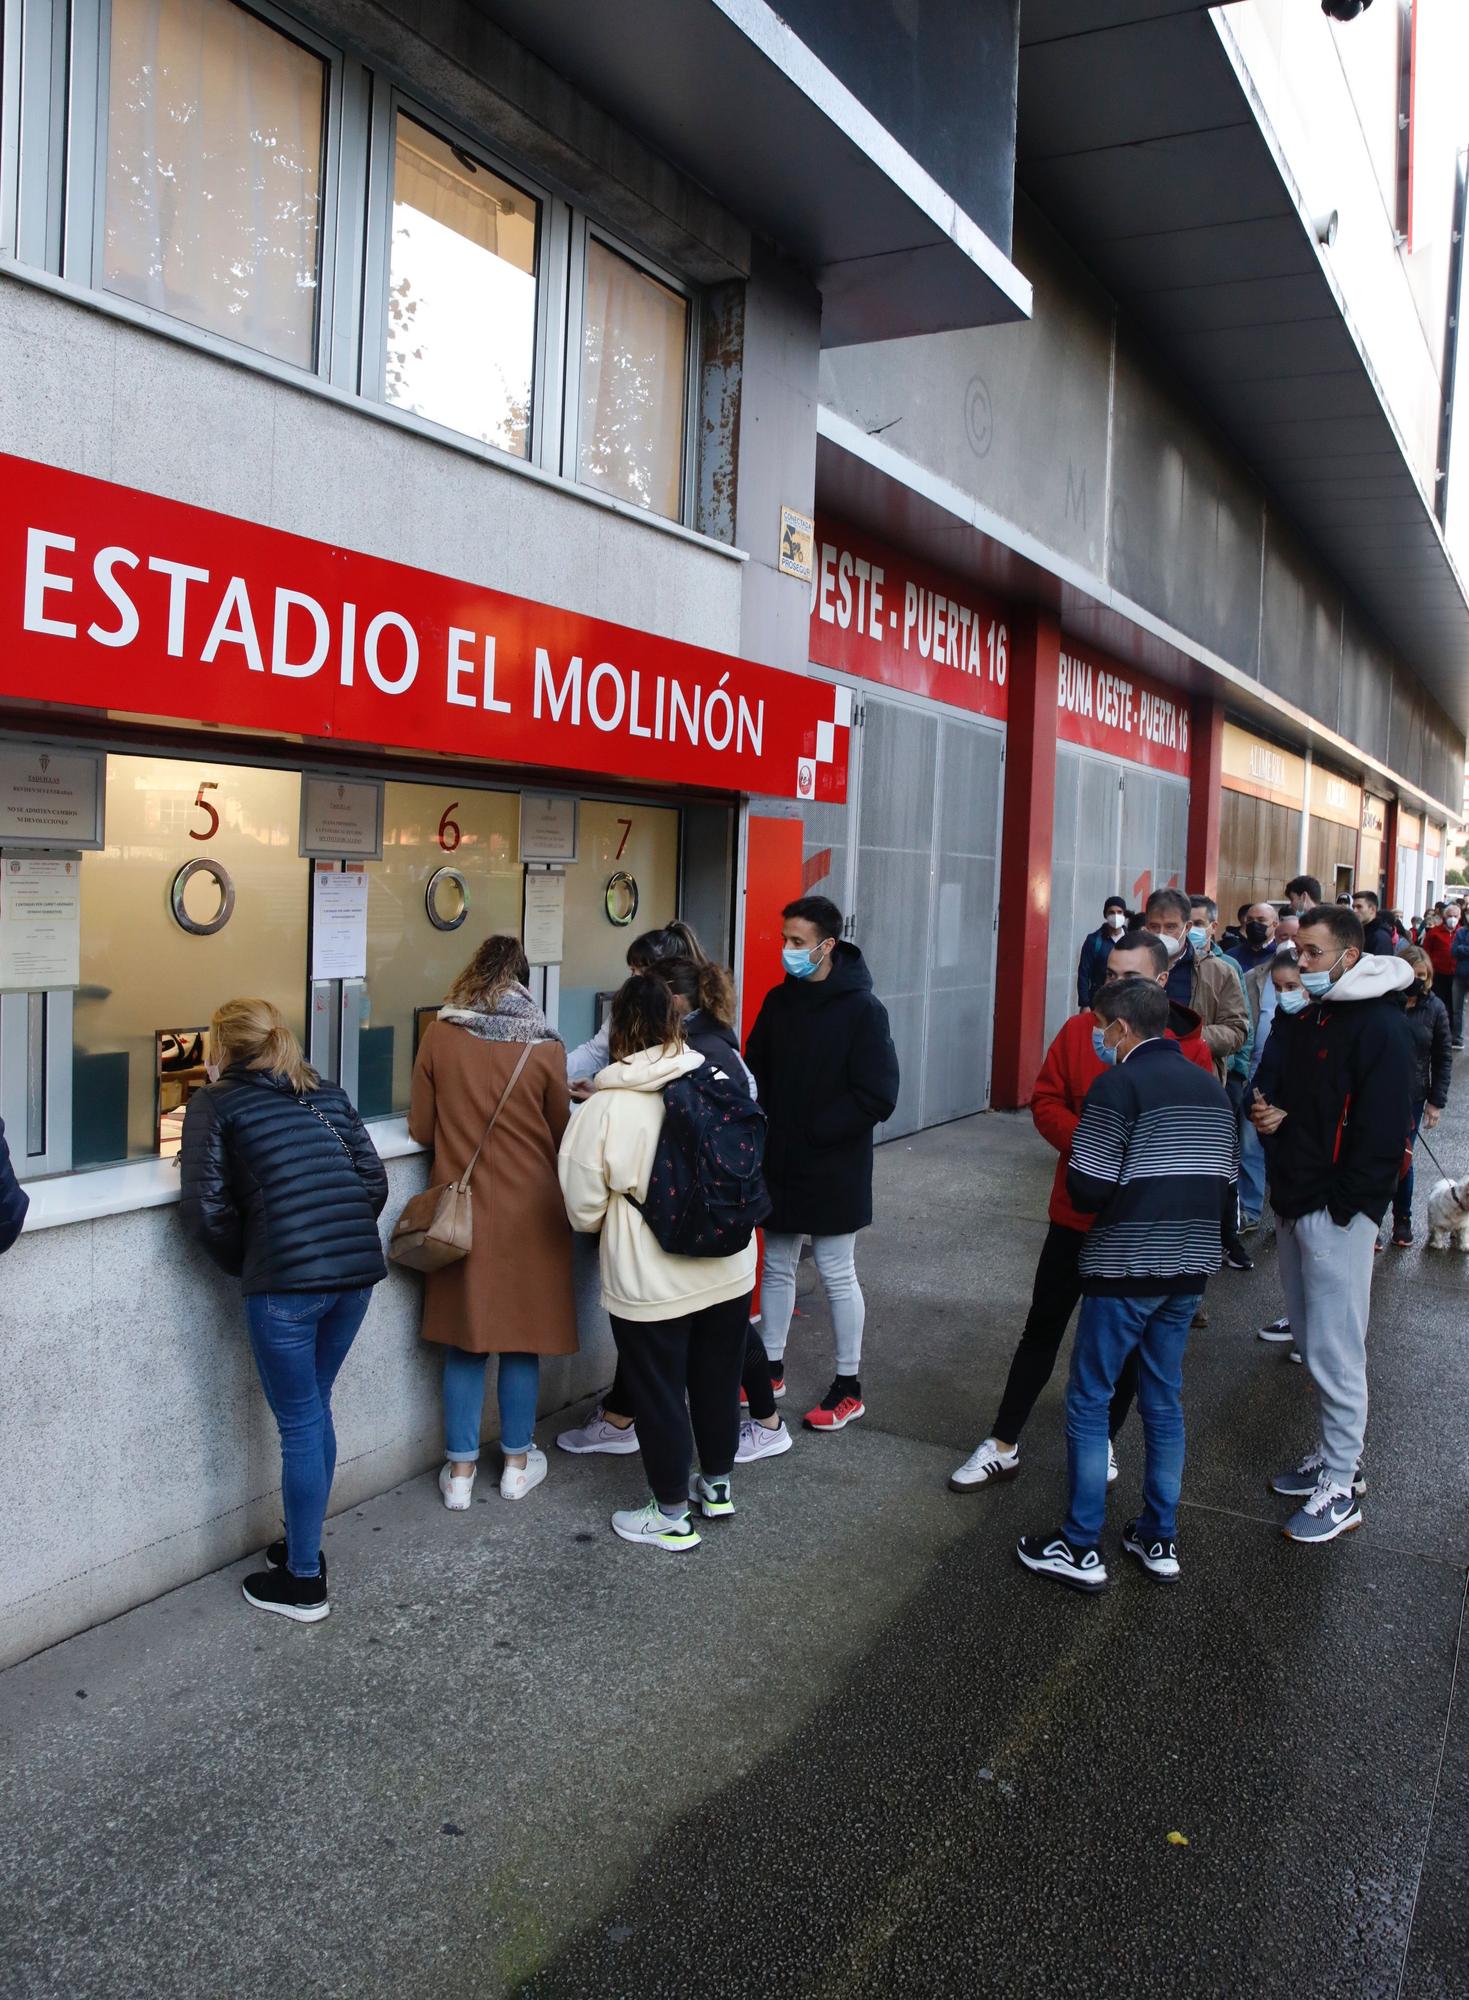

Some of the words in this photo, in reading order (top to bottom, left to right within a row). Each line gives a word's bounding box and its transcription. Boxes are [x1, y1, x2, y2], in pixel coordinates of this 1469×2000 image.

[781, 557, 811, 576] PROSEGUR
[23, 527, 419, 694] ESTADIO
[446, 626, 511, 714] EL
[533, 648, 765, 757] MOLINÓN
[903, 581, 981, 678] PUERTA
[987, 619, 1007, 687] 16
[1057, 651, 1093, 718] BUNA
[1096, 670, 1133, 733] OESTE
[1139, 690, 1176, 748] PUERTA
[1178, 707, 1188, 753] 16
[189, 782, 219, 841] 5
[438, 801, 460, 851] 6
[616, 818, 632, 860] 7
